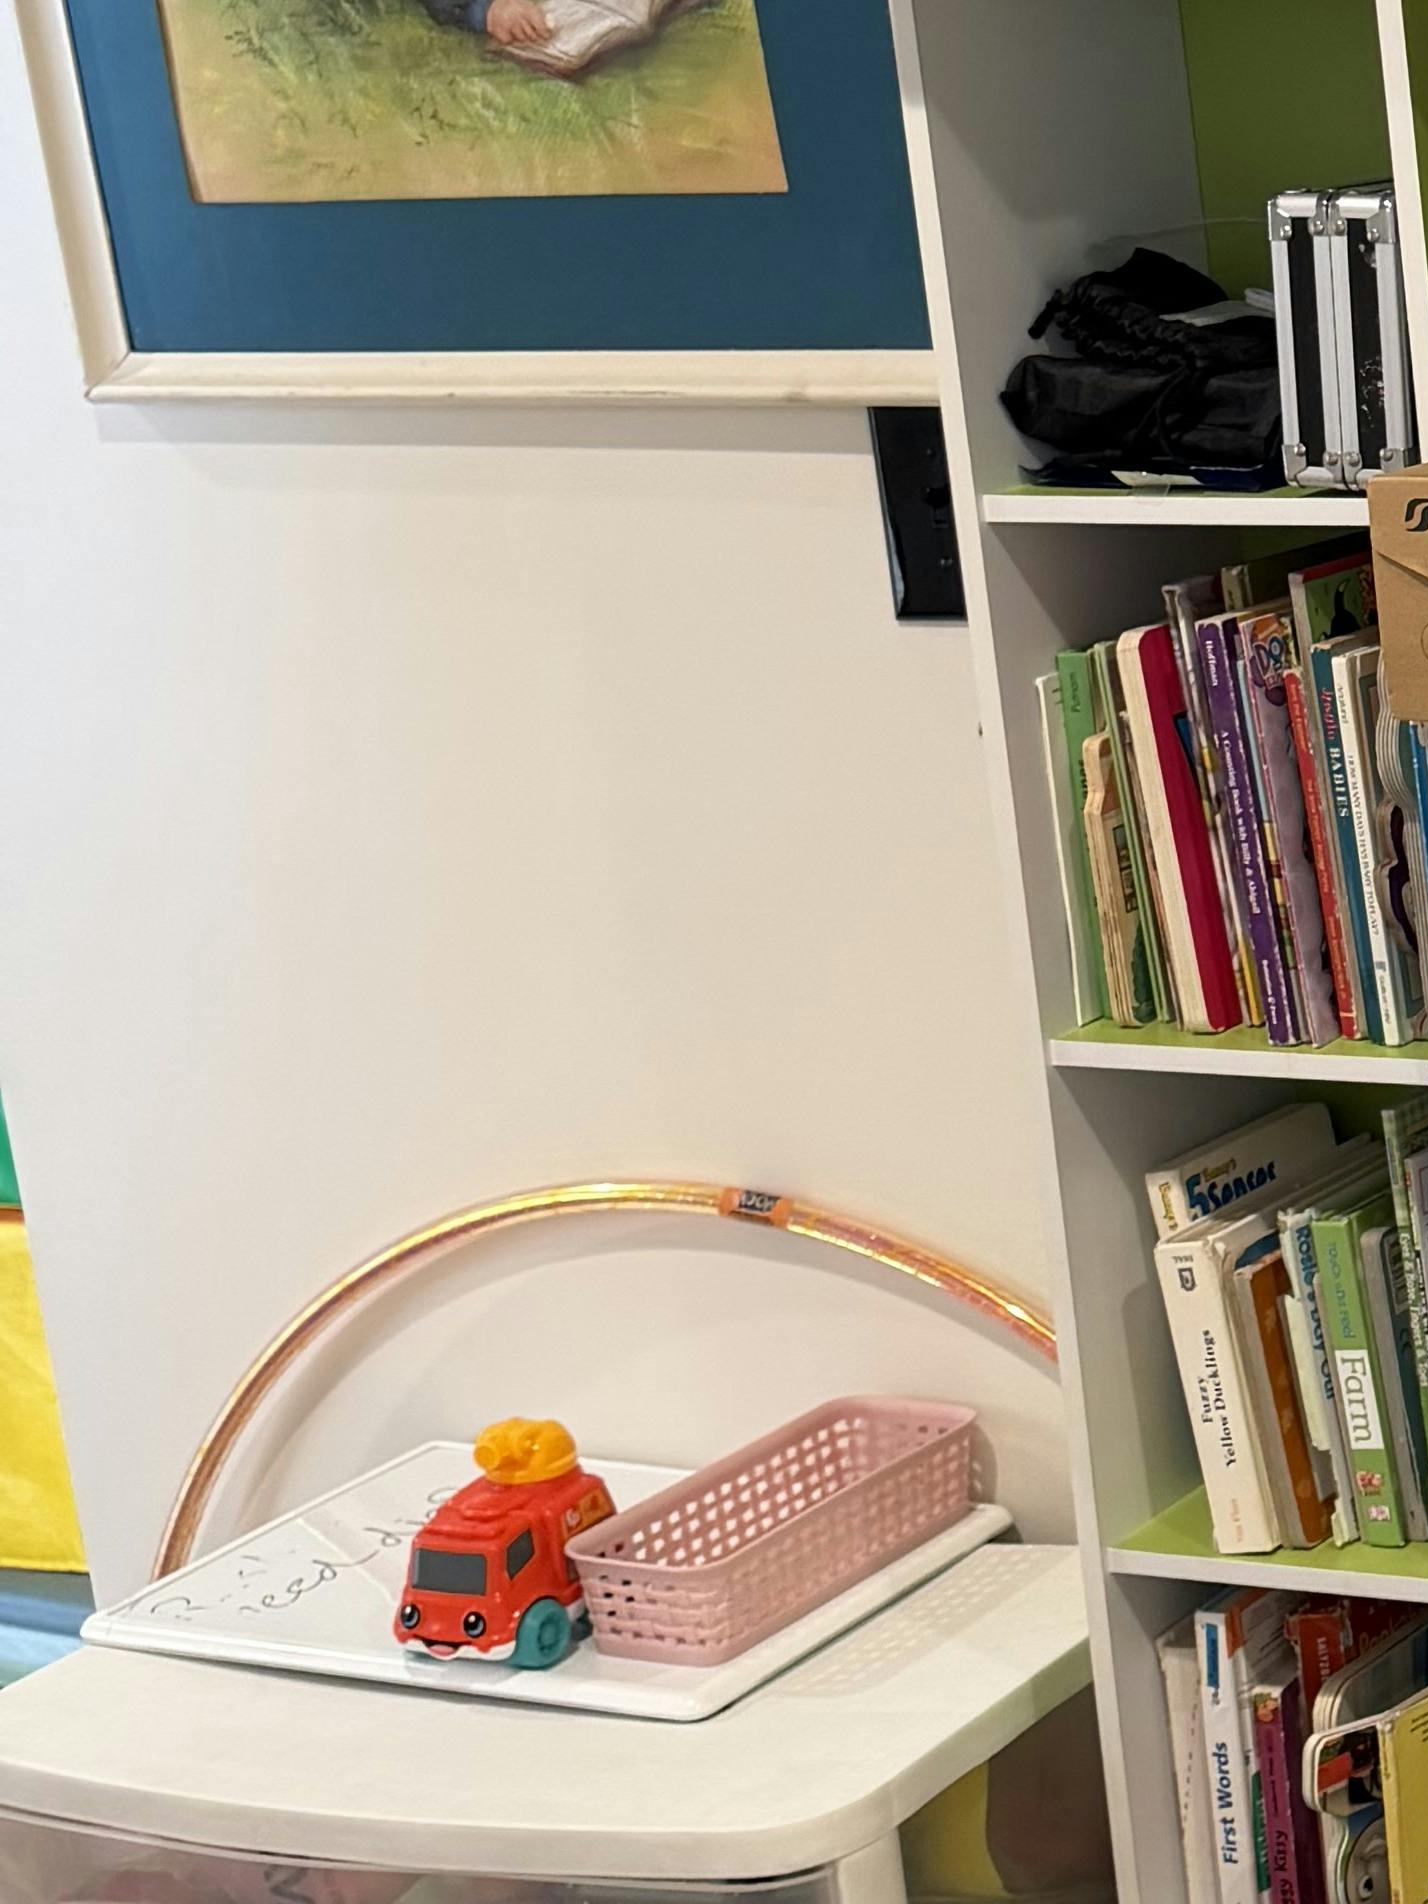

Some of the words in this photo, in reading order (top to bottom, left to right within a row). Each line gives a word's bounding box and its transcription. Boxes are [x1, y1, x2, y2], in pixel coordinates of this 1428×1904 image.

[1196, 1377, 1213, 1424] Fuzzy
[1201, 1330, 1227, 1412] Ducklings
[1340, 1355, 1376, 1443] Farm
[1217, 1415, 1237, 1468] Yellow
[1212, 1742, 1233, 1810] Words
[1219, 1816, 1239, 1864] First
